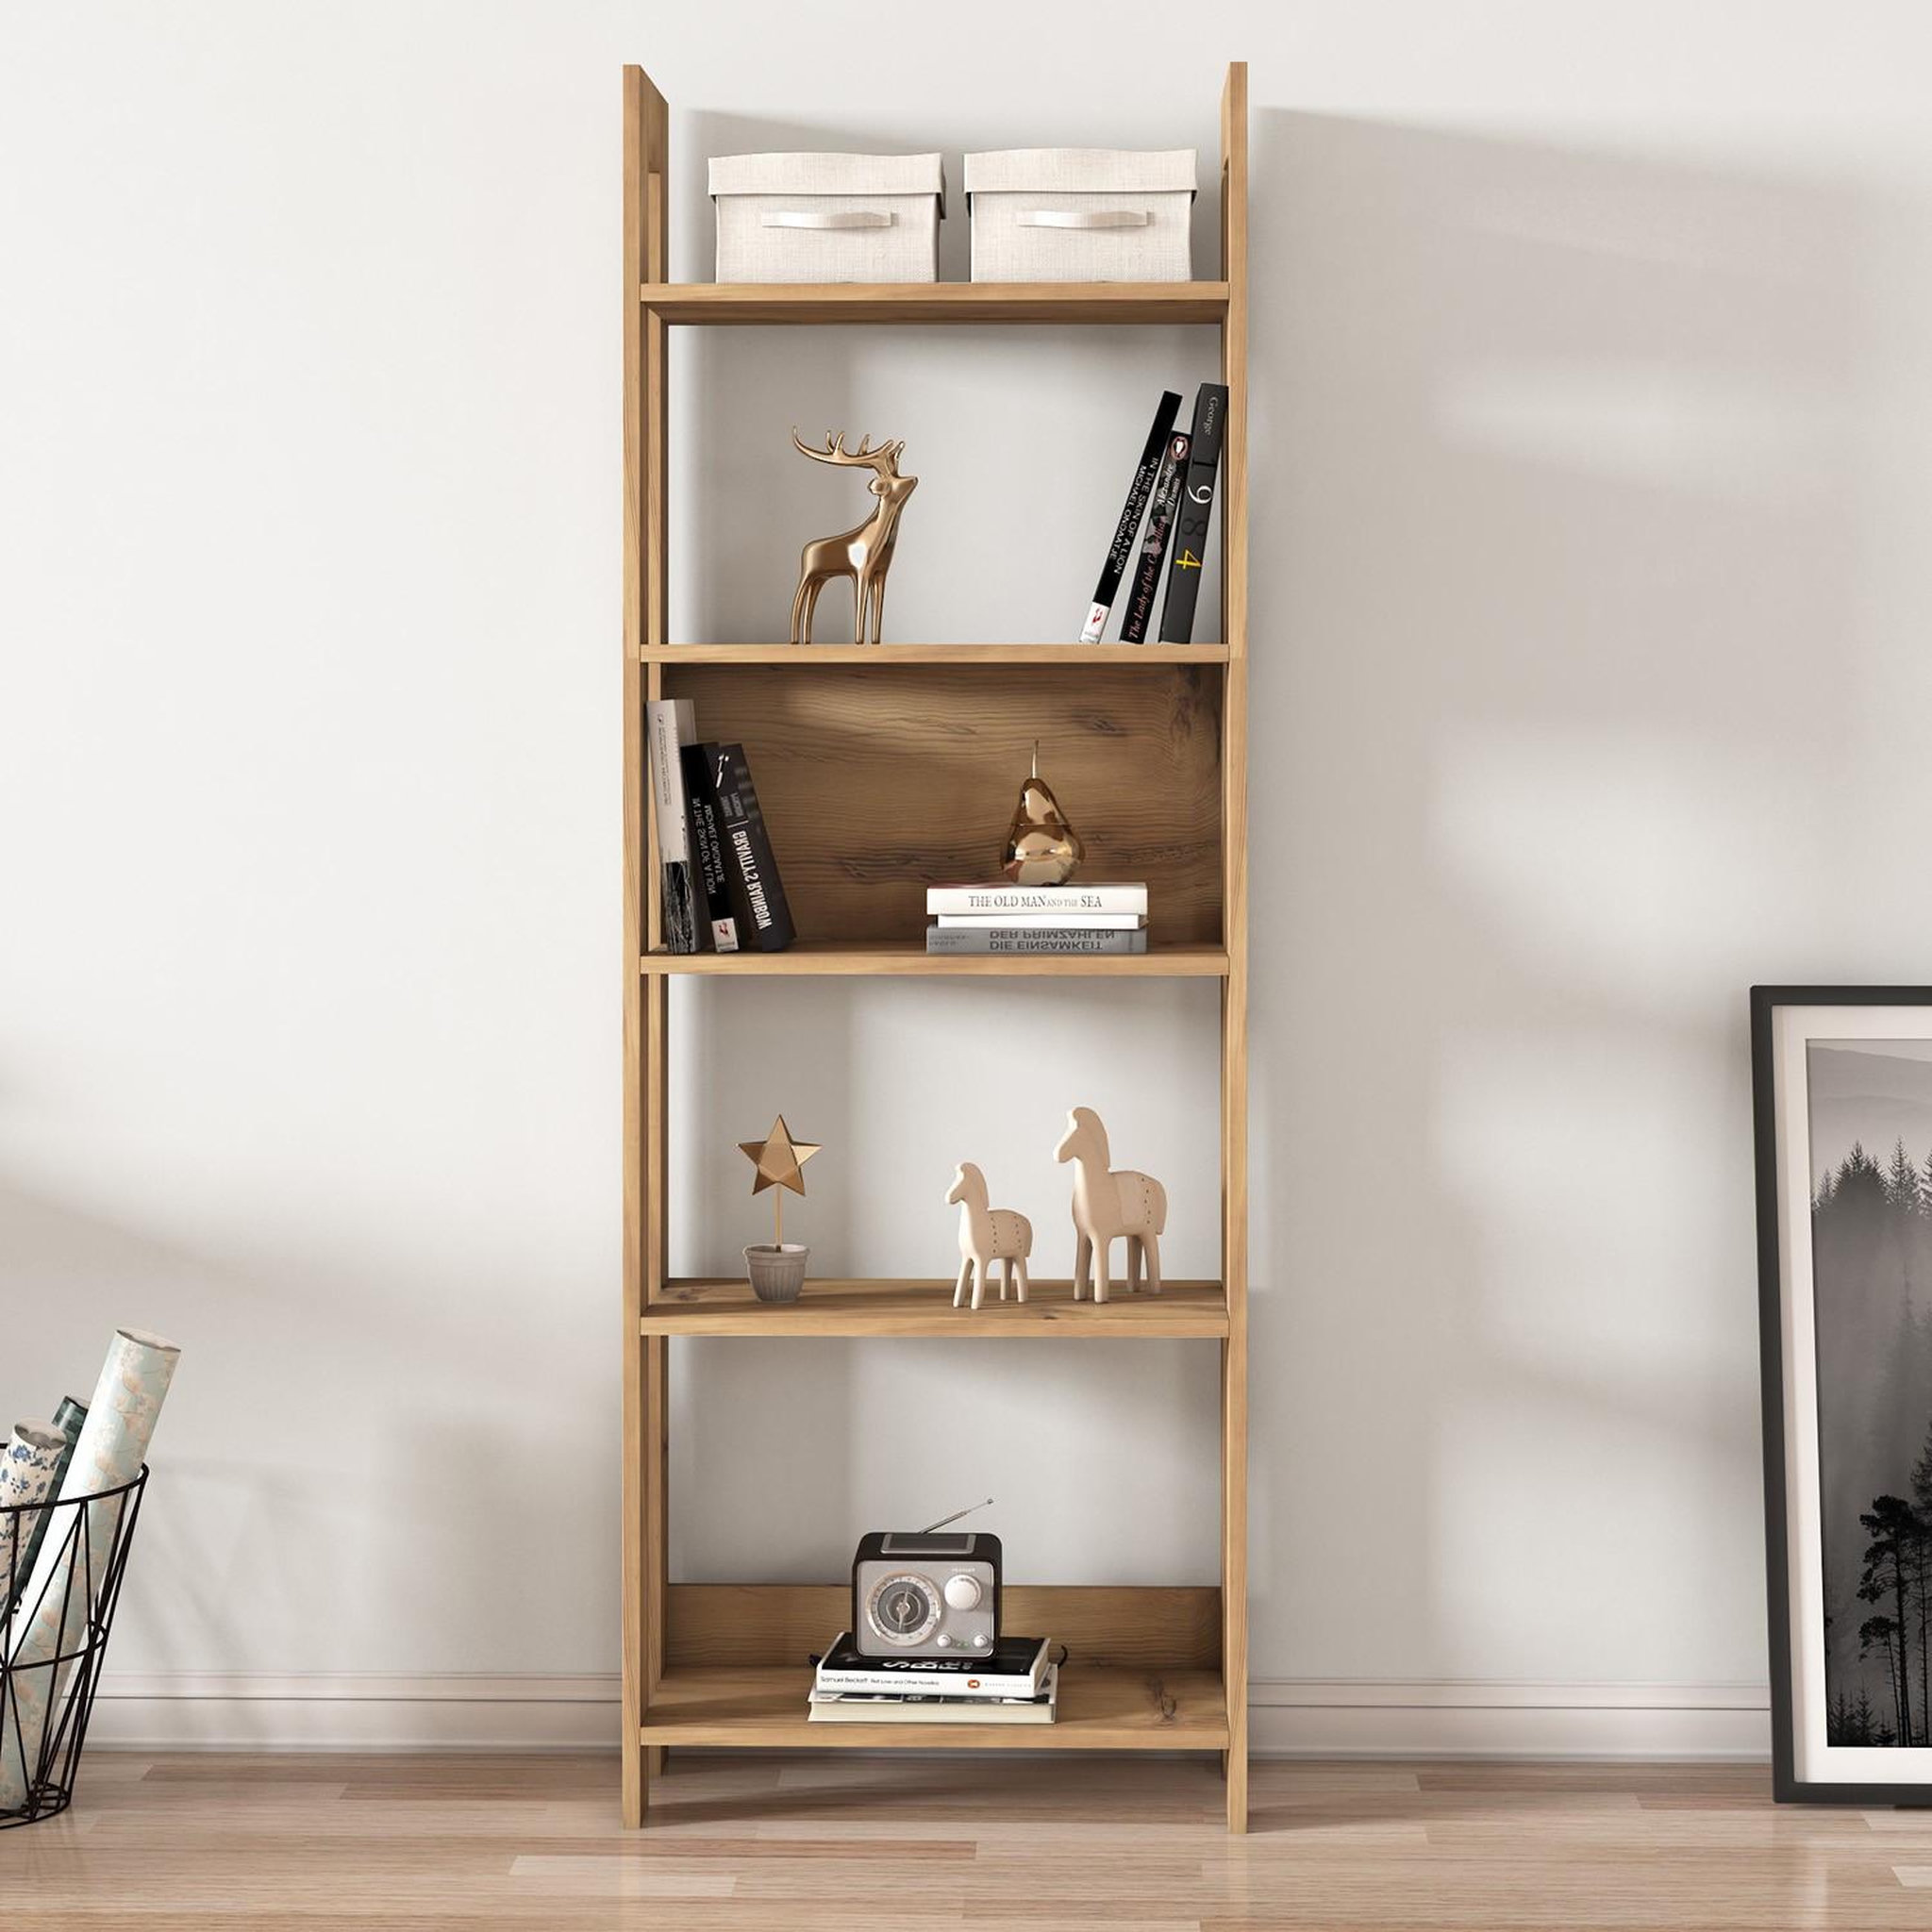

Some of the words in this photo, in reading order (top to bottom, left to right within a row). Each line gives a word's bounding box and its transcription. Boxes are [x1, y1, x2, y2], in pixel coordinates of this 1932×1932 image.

[1203, 396, 1219, 436] George
[1150, 458, 1159, 469] IN
[1127, 465, 1147, 507] MICHAEL
[1141, 472, 1154, 492] THE
[1132, 494, 1146, 520] SKIN
[1109, 509, 1132, 560] ONDAATJE
[1127, 521, 1137, 538] OF
[1114, 548, 1128, 575] LION
[1143, 565, 1155, 581] the
[1142, 579, 1154, 596] of
[1133, 597, 1150, 620] Lady
[1128, 621, 1141, 639] The
[968, 895, 991, 907] THE
[993, 895, 1019, 907] OLD
[1021, 895, 1046, 908] MAN
[1046, 898, 1063, 907] AND
[1063, 898, 1078, 907] THE
[1080, 895, 1103, 908] SEA
